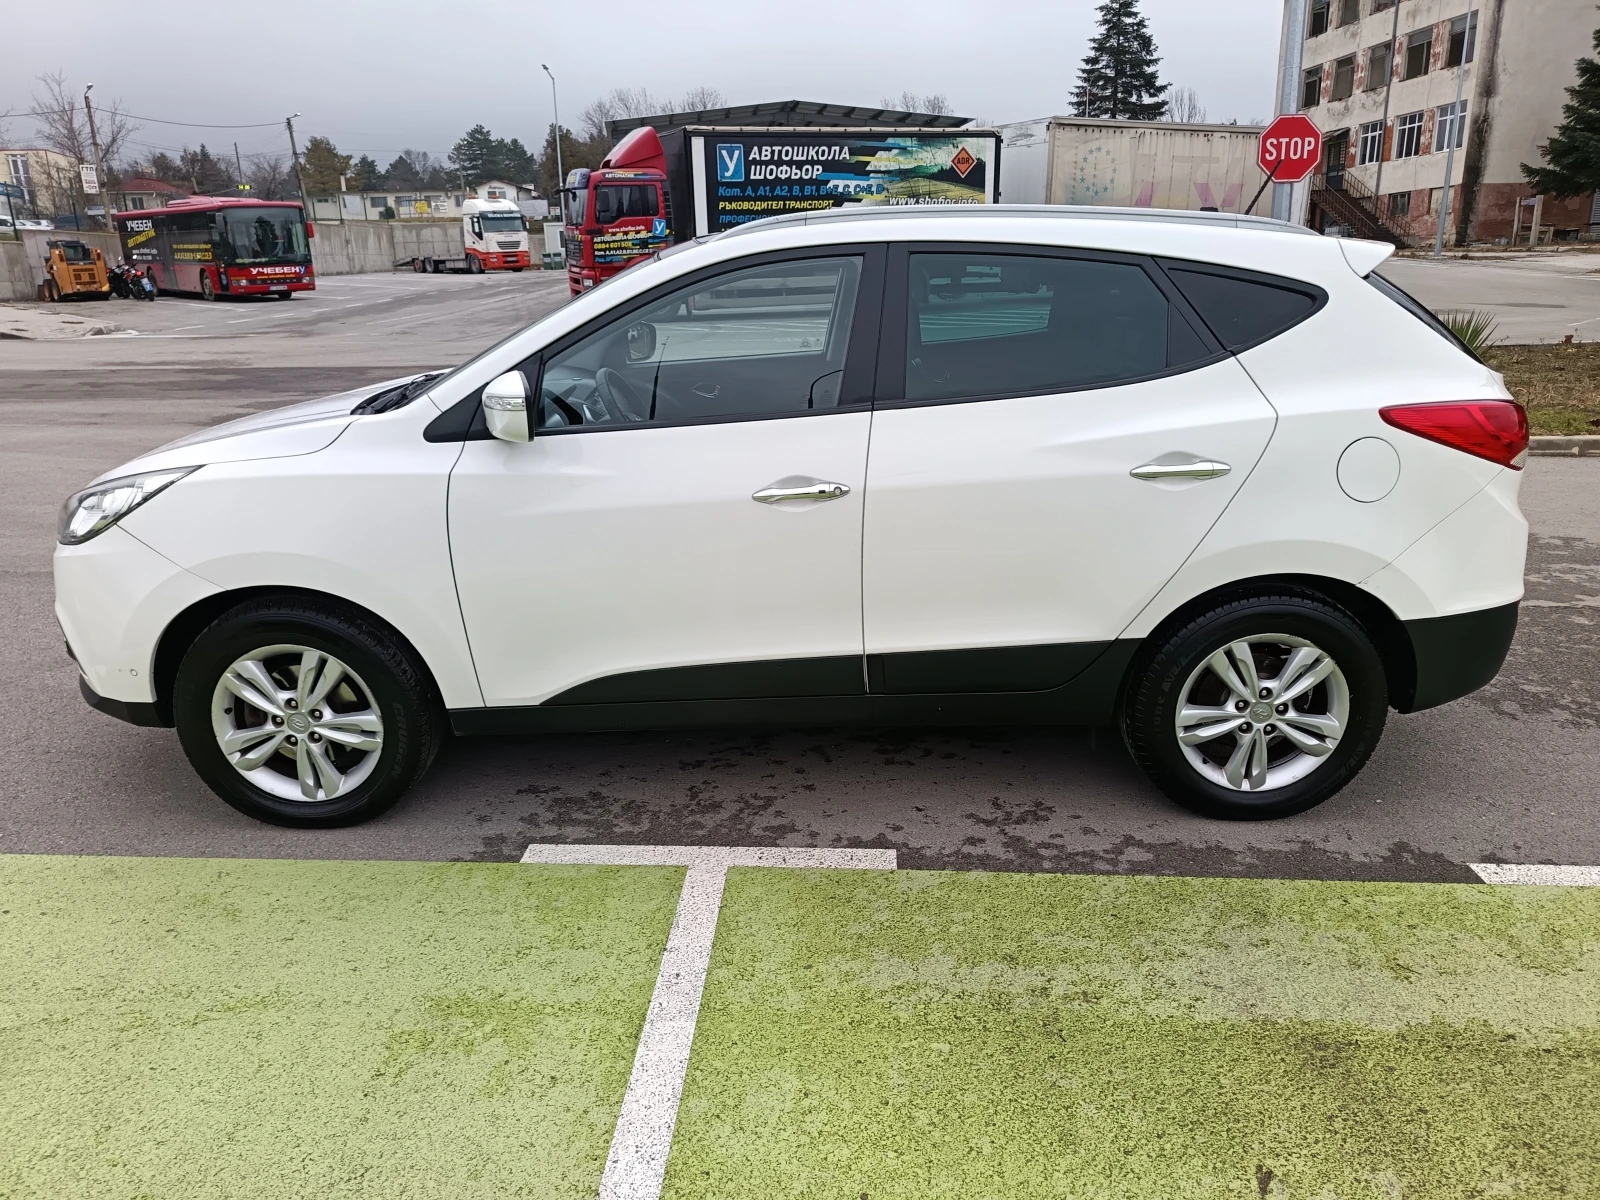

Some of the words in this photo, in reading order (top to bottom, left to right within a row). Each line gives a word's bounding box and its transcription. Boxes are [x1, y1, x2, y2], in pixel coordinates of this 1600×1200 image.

[748, 145, 850, 161] АВТОШКОЛА
[1265, 136, 1316, 161] STOP
[719, 149, 741, 178] У
[956, 156, 970, 166] ADR
[750, 164, 823, 180] ШОФЬОР
[718, 186, 743, 197] Кат.
[718, 201, 784, 211] РЪКОВОДИТЕЛ
[785, 200, 834, 210] ТРАНСПОРТ
[126, 219, 153, 232] УЧЕБЕН
[250, 266, 300, 275] УЧЕБЕН
